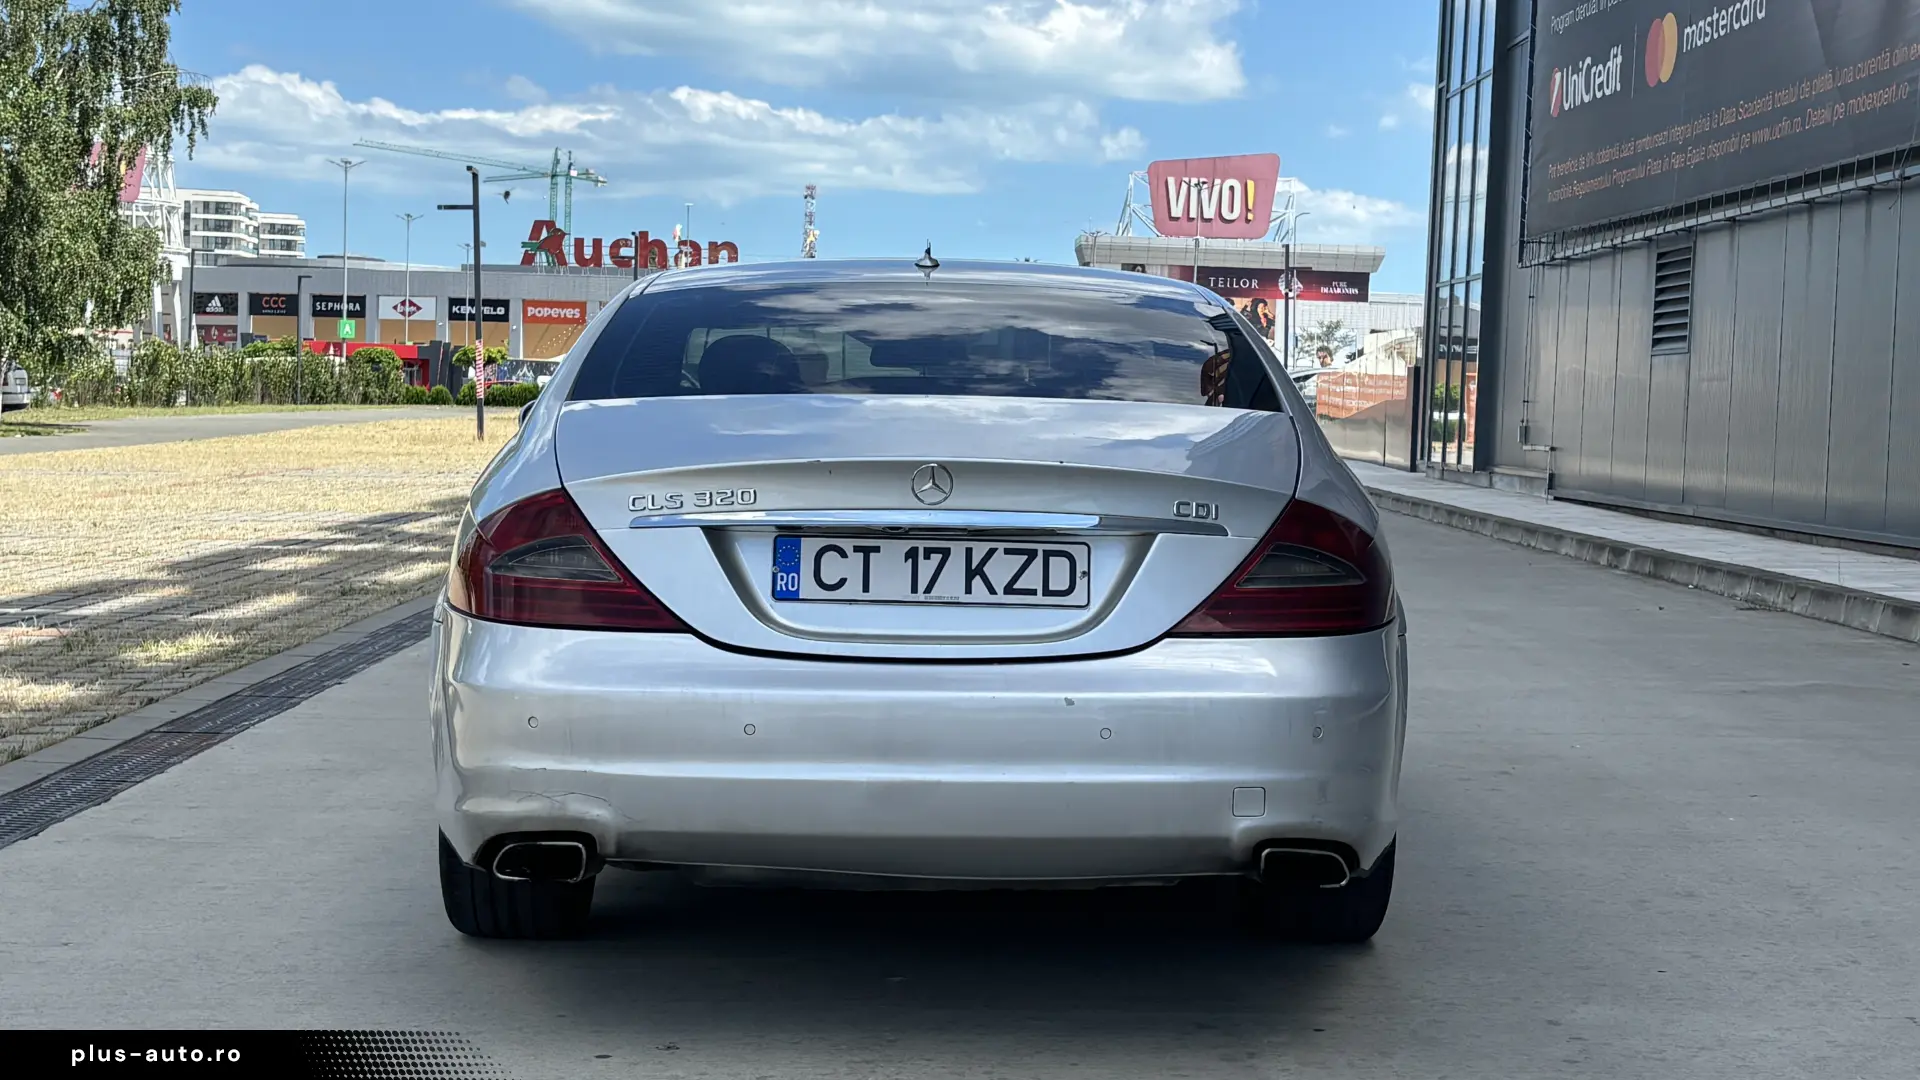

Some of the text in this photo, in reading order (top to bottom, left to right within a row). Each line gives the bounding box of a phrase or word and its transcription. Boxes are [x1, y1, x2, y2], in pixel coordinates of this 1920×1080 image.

[1683, 0, 1766, 53] mastercard
[1563, 44, 1622, 111] UniCredit
[1800, 76, 1811, 100] de
[1855, 48, 1890, 80] curentă
[1740, 133, 1751, 155] pe
[1805, 101, 1833, 129] Detalii
[1832, 102, 1845, 128] pe
[1847, 81, 1909, 115] mobexpert.ro
[1167, 176, 1254, 221] VIVO!
[521, 220, 738, 269] Auchan
[1209, 277, 1259, 289] TEILOR
[262, 297, 286, 308] CCC
[316, 301, 361, 311] SEPHORA
[344, 323, 351, 334] A
[628, 488, 757, 511] CLS 320
[1173, 500, 1219, 520] CDI
[776, 573, 798, 591] RO
[813, 544, 1077, 597] CT 17 KZD
